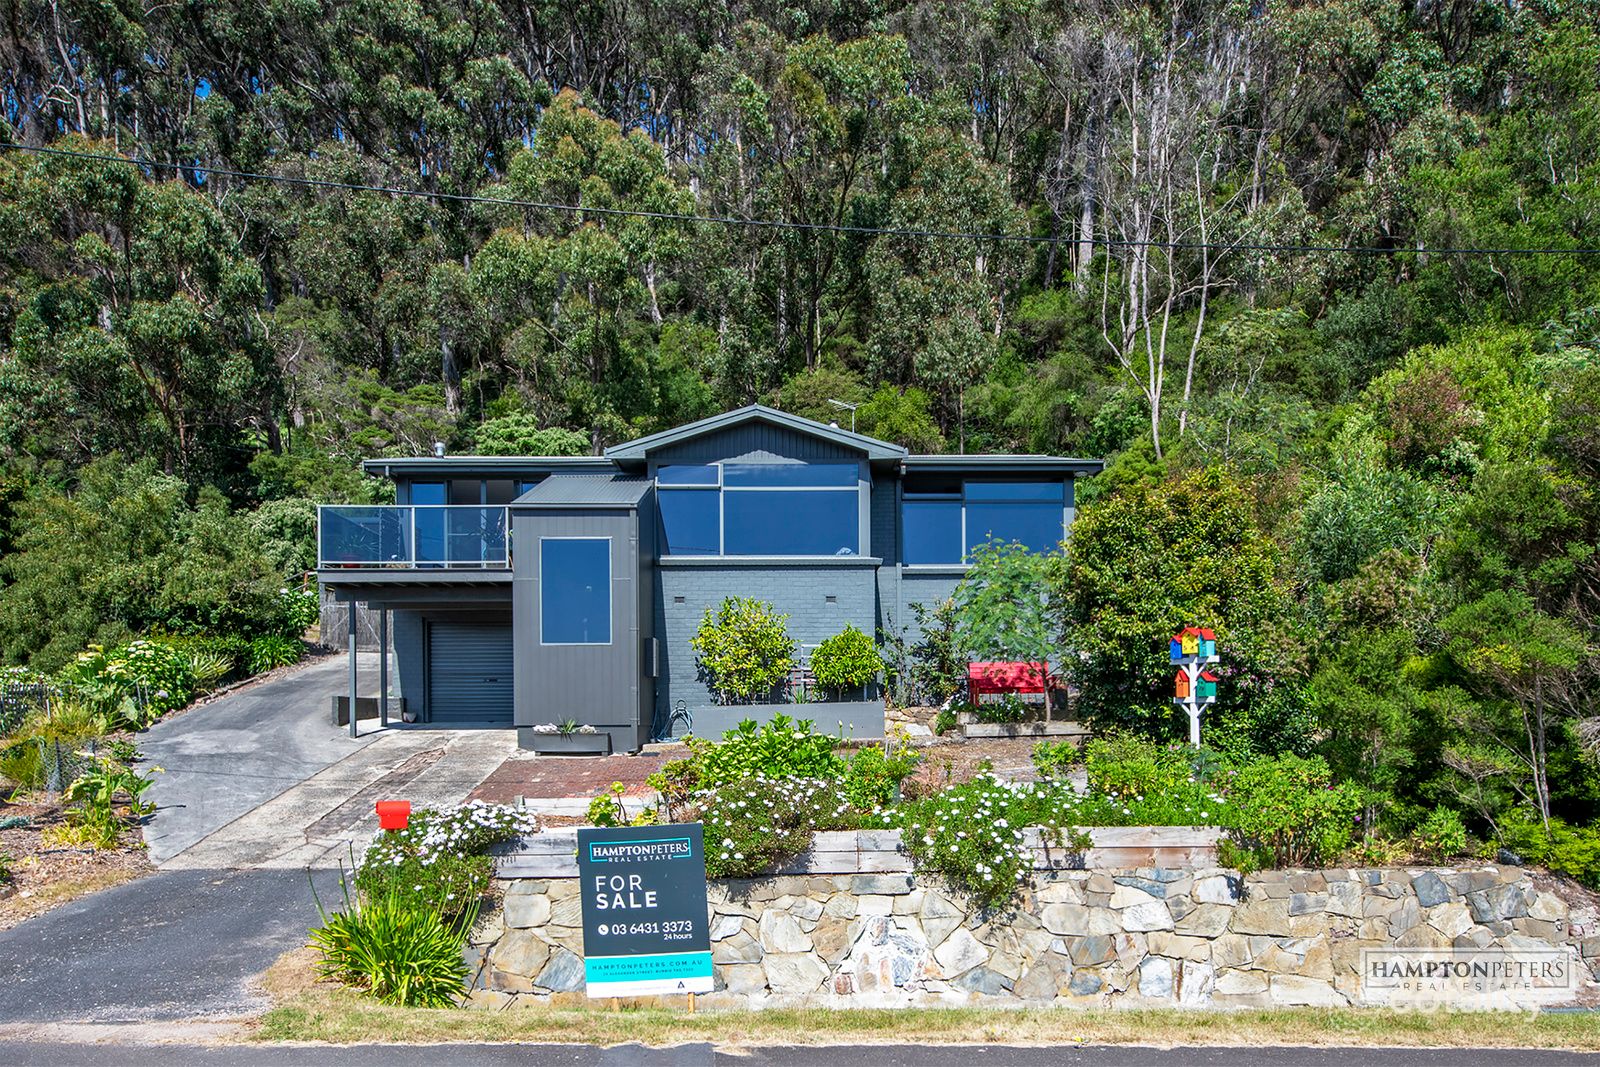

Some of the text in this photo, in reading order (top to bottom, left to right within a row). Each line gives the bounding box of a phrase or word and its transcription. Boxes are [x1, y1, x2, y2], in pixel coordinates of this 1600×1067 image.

[592, 842, 689, 857] HAMPTONPETERS
[608, 853, 673, 863] REAL ESTATE
[595, 874, 643, 892] FOR
[596, 891, 658, 910] SALE
[611, 920, 693, 935] 03 6431 3373
[673, 932, 693, 940] hours
